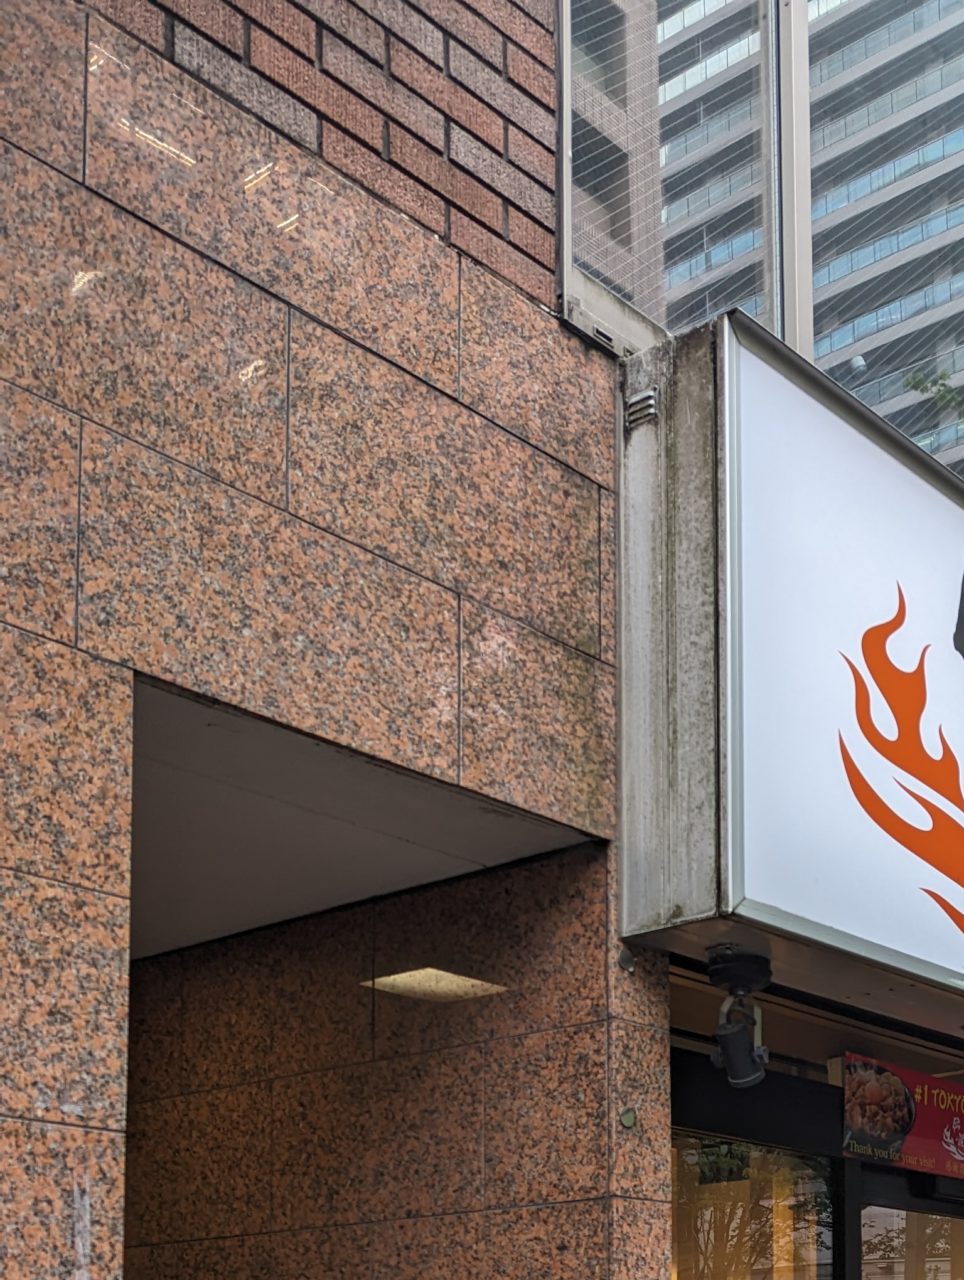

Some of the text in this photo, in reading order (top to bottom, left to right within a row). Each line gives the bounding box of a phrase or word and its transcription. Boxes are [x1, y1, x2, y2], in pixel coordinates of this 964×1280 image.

[914, 1084, 928, 1104] #1
[849, 1140, 871, 1157] Thank
[872, 1147, 888, 1160] you
[888, 1147, 900, 1161] for
[901, 1152, 917, 1166] your
